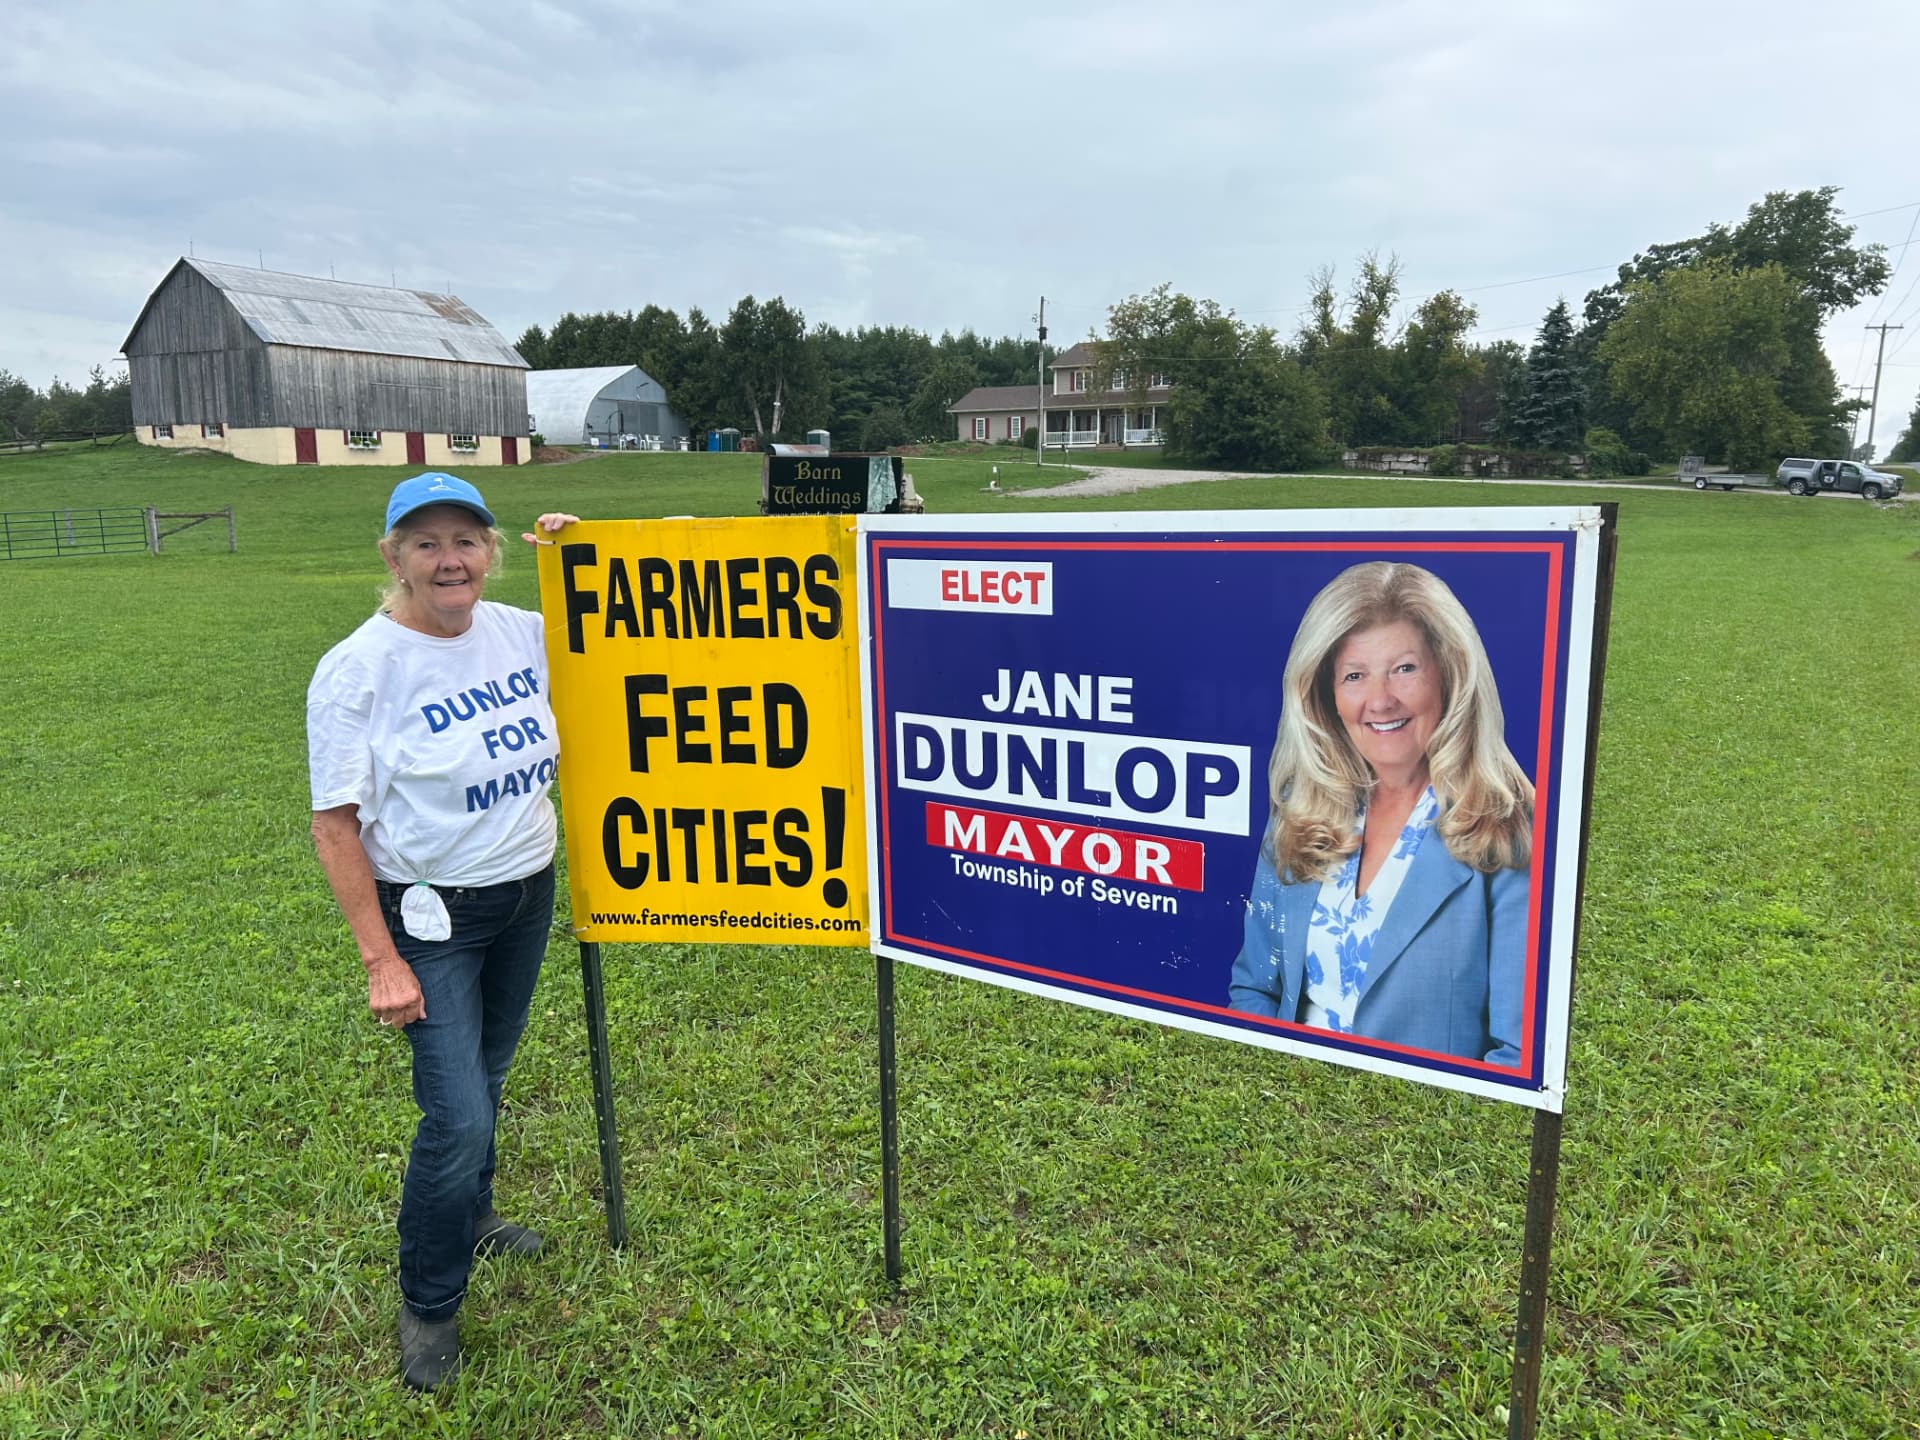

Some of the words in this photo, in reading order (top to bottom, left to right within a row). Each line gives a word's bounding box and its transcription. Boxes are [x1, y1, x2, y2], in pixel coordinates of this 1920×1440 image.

[772, 485, 862, 509] Weddings
[793, 460, 842, 481] Barn
[561, 543, 843, 655] FARMERS
[941, 569, 1046, 605] ELECT
[624, 673, 809, 774] FEED
[982, 668, 1134, 724] JANE
[480, 716, 548, 760] FOR
[902, 721, 1241, 820] DUNLOP
[602, 785, 849, 910] CITIES!
[943, 809, 1174, 886] MAYOR
[950, 853, 1054, 896] Township
[1060, 875, 1086, 899] of
[1090, 879, 1179, 915] Severn
[590, 907, 862, 932] www.farmersfeedcities.com
